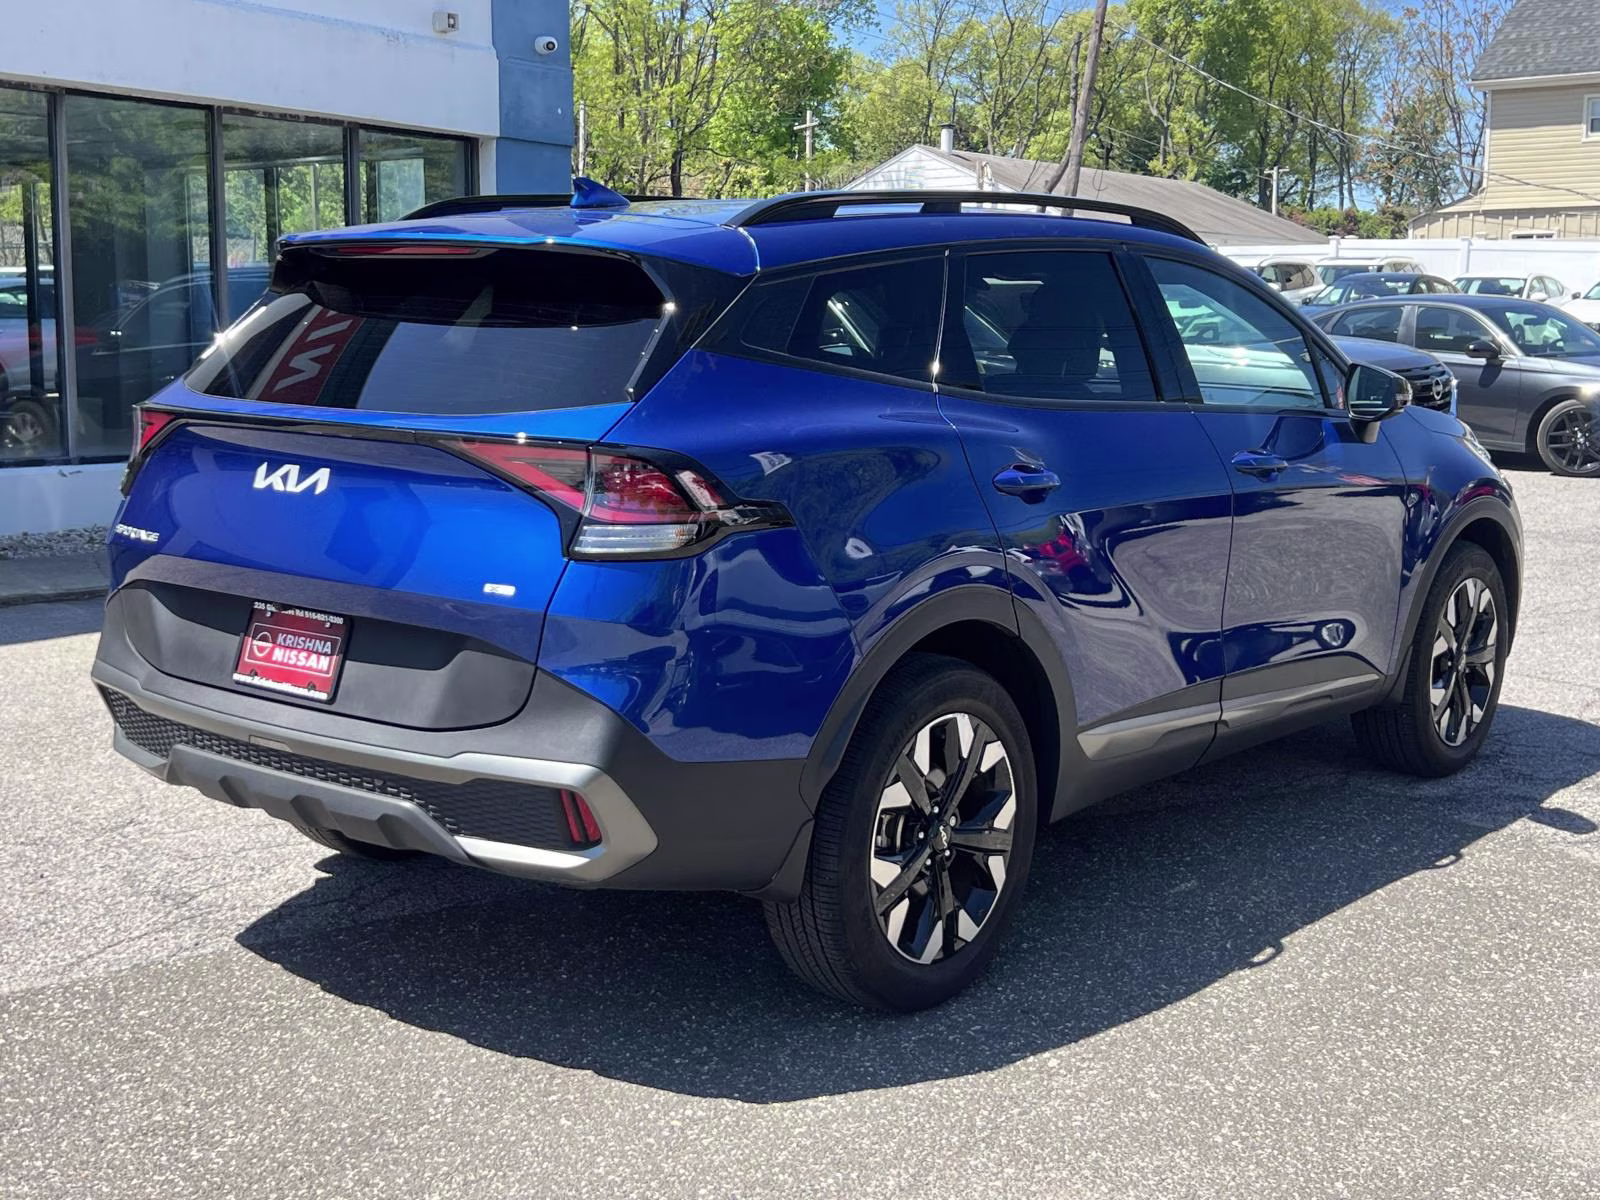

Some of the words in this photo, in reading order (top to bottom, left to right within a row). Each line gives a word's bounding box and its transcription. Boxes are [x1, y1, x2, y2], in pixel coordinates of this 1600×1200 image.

[252, 461, 331, 495] KIA
[276, 632, 332, 655] KRISHNA
[271, 647, 330, 671] NISSAN
